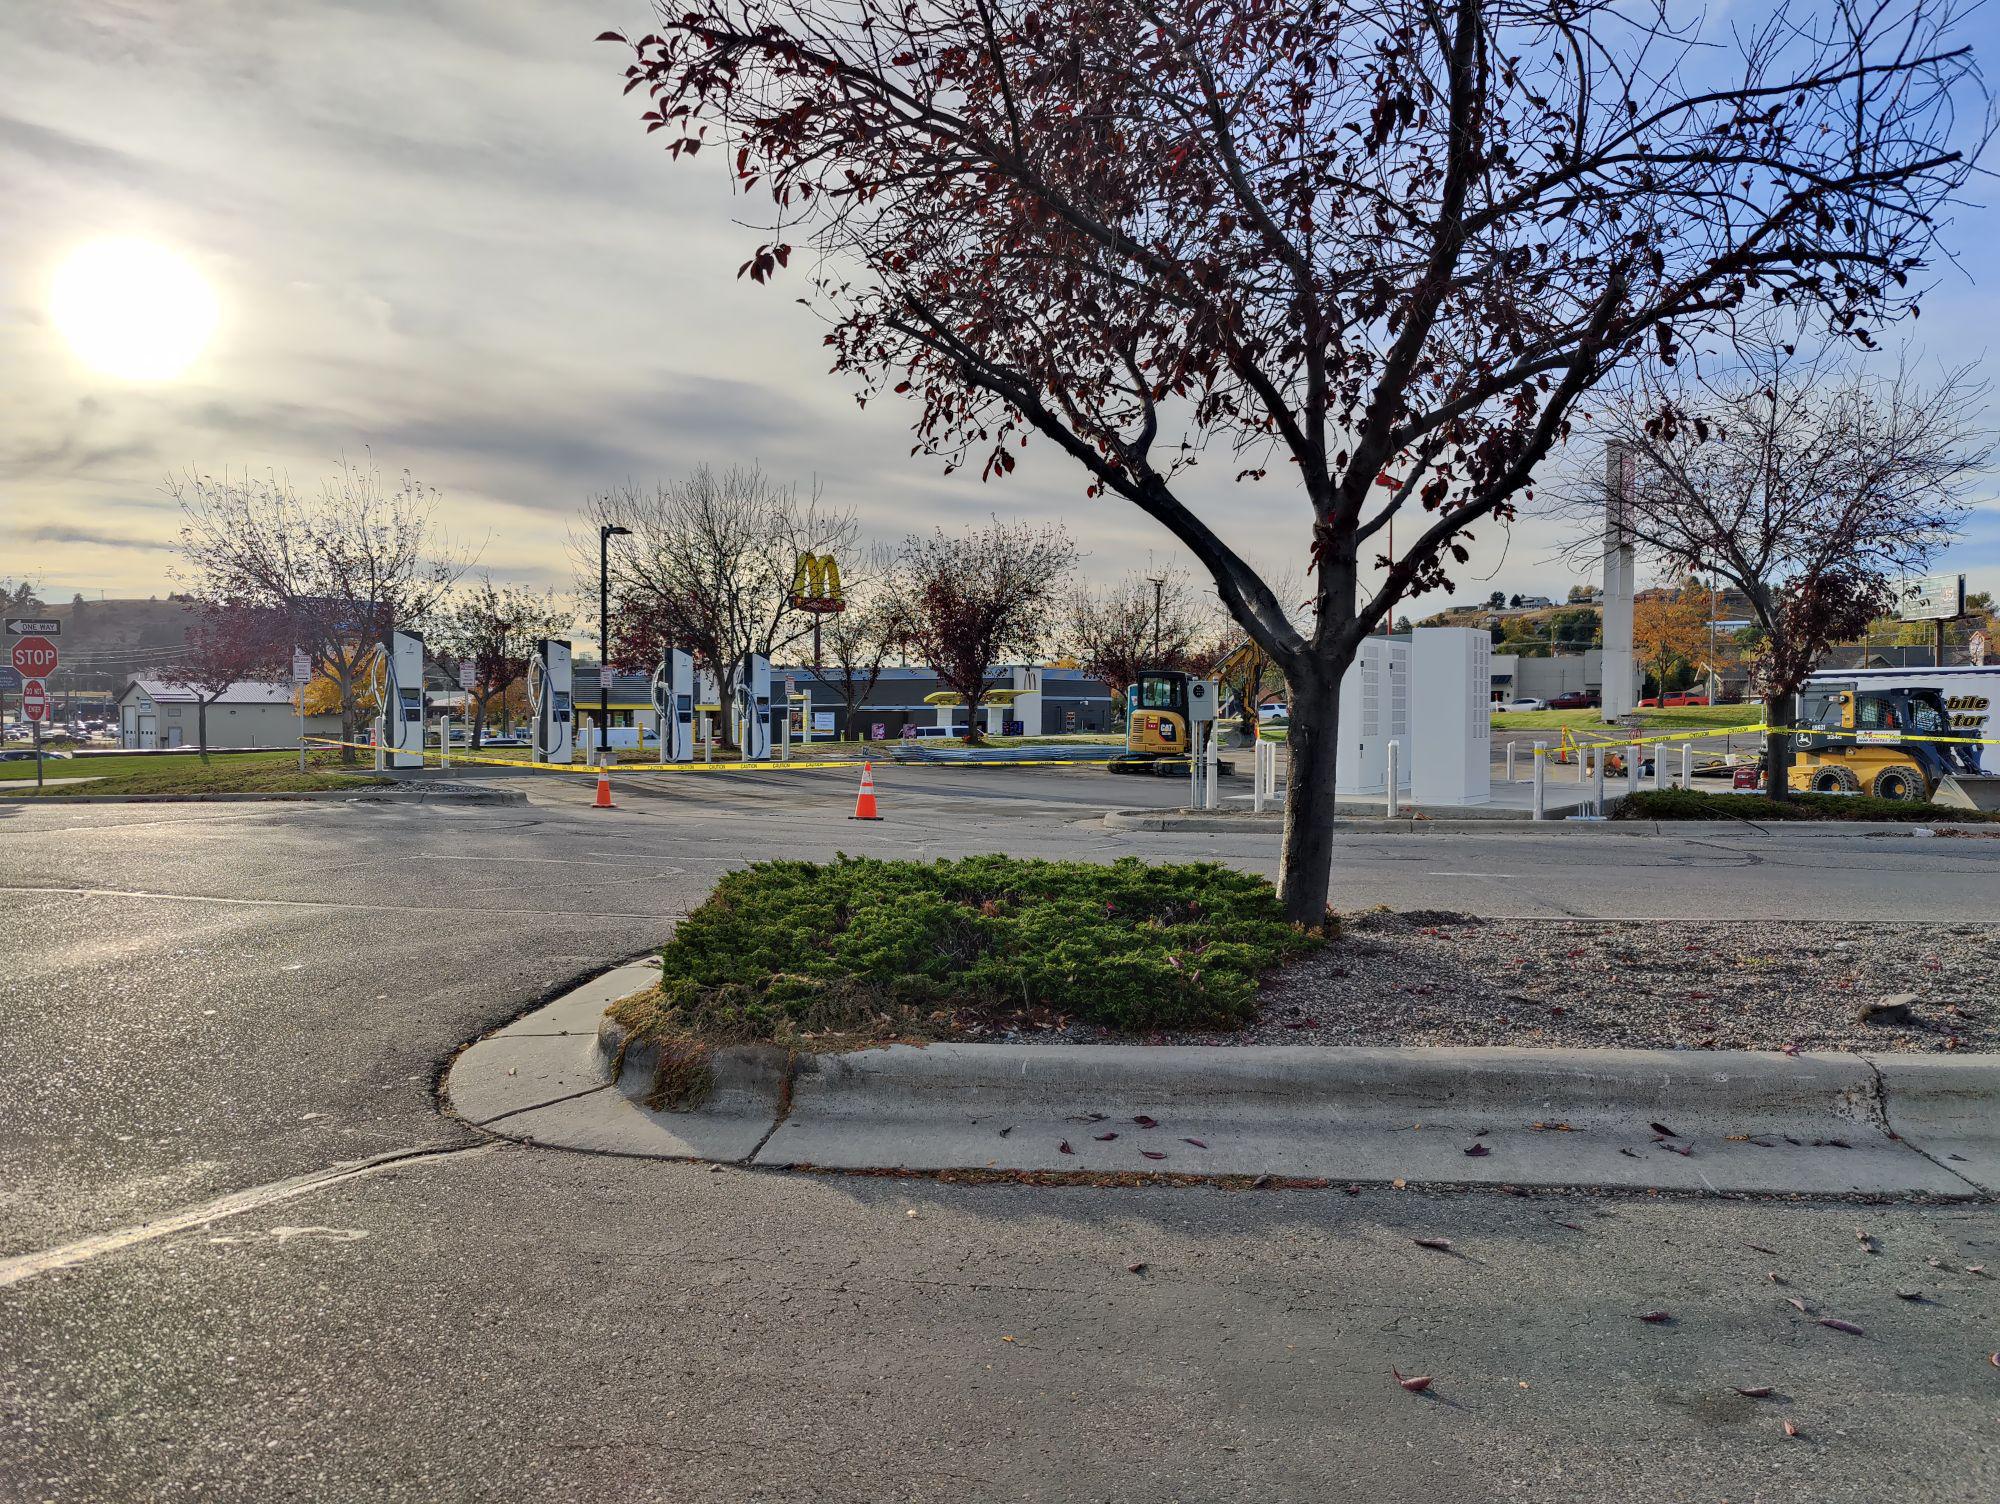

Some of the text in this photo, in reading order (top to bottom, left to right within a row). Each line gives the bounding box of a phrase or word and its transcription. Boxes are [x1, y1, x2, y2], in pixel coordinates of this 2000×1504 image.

[22, 623, 37, 631] ONE
[15, 649, 55, 665] STOP
[1161, 723, 1173, 732] CAT
